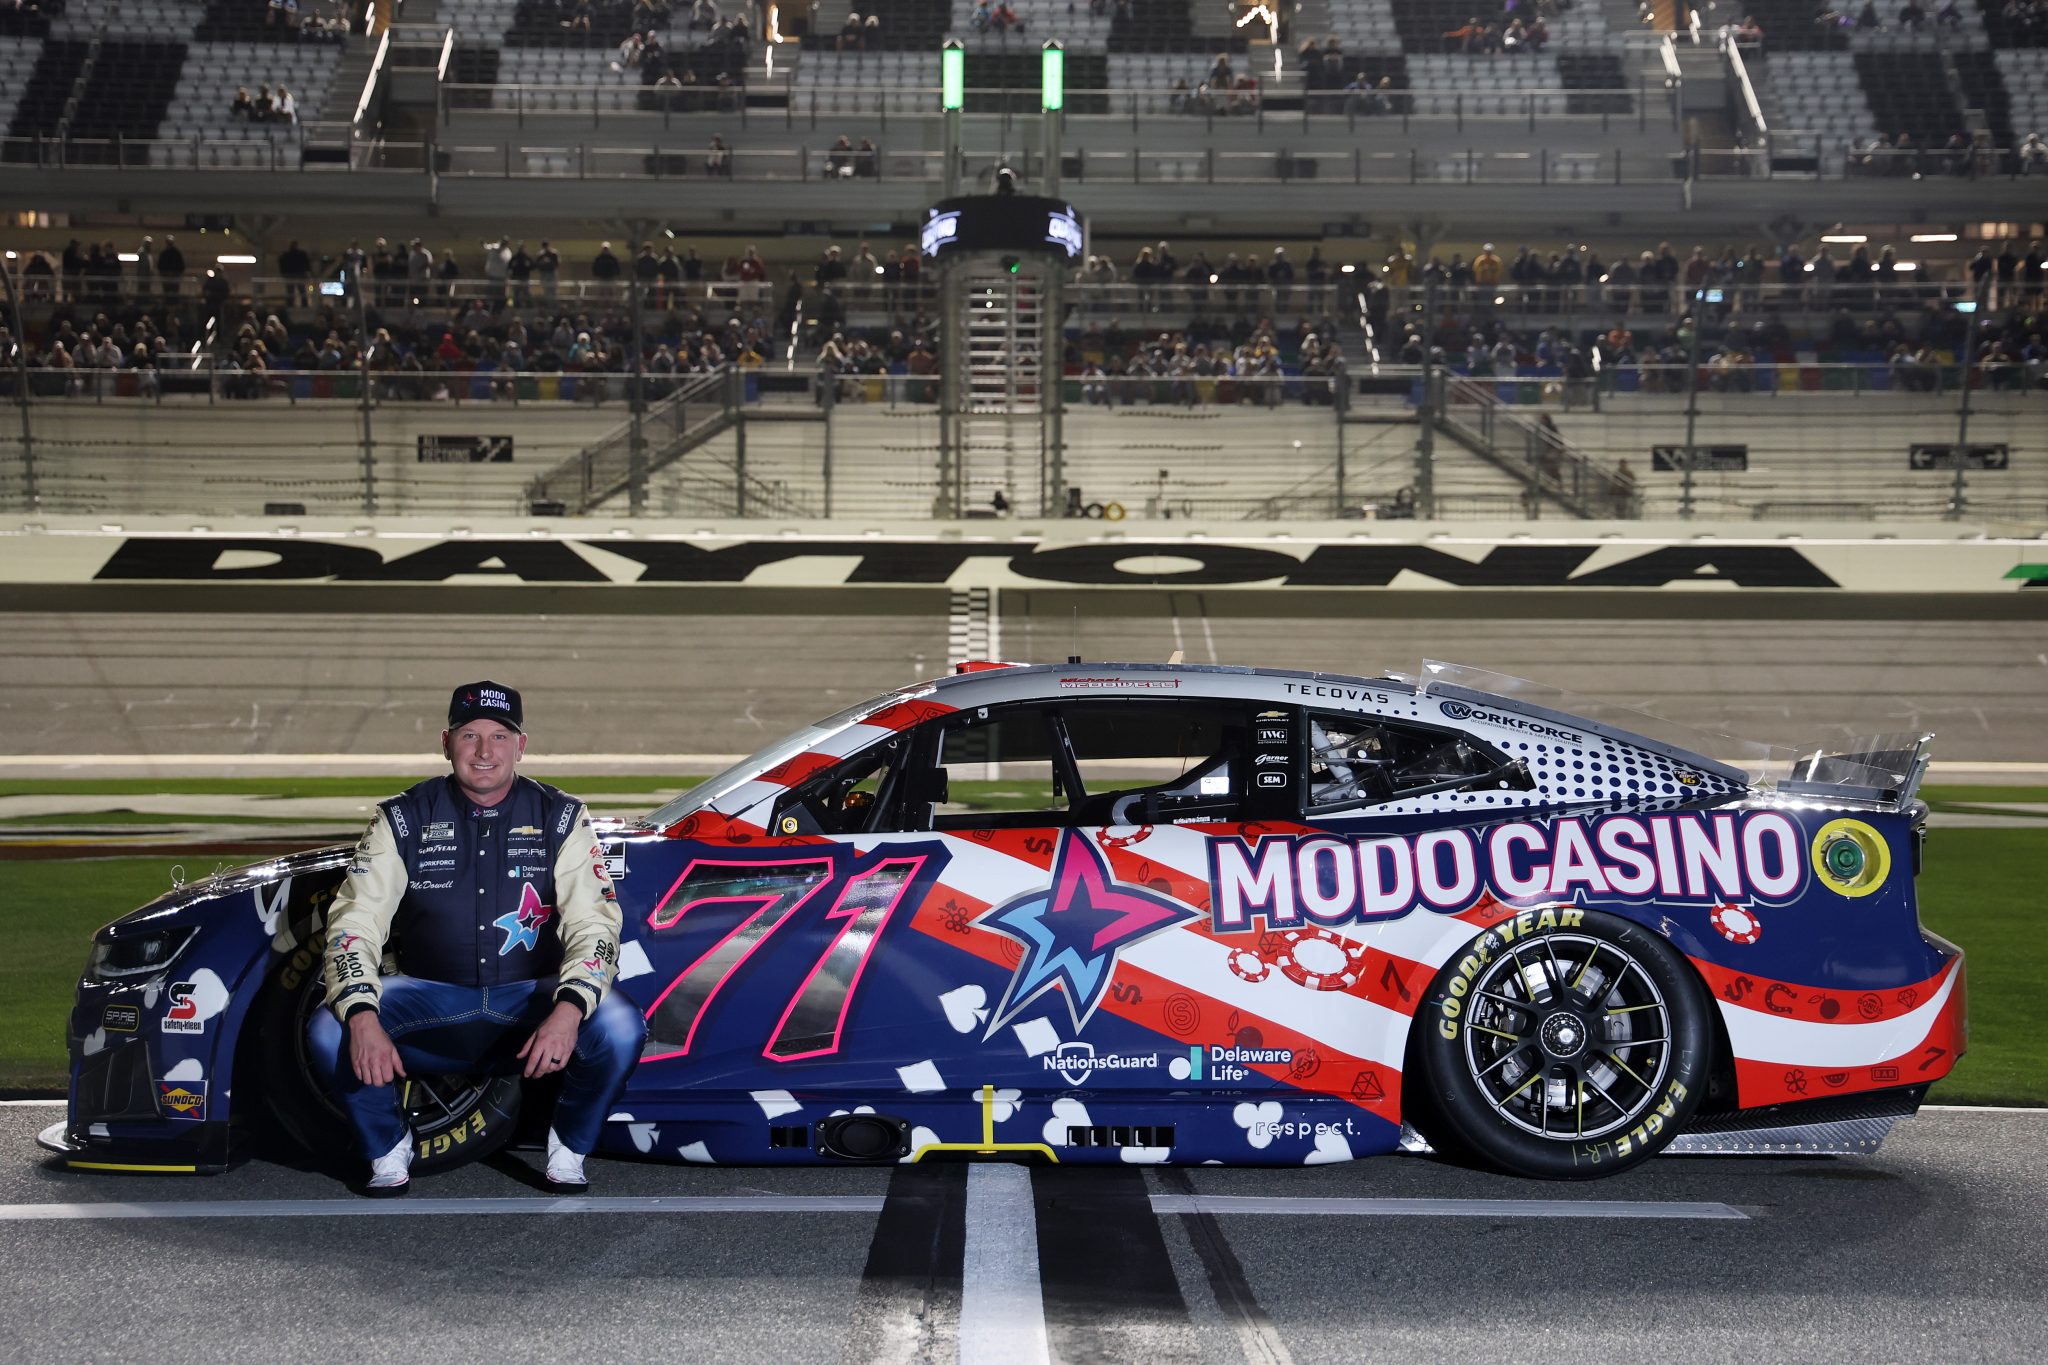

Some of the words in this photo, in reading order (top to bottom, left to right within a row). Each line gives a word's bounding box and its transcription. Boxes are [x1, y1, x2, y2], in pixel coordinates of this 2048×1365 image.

[92, 537, 1843, 589] DAYTONA
[480, 689, 506, 701] MODO
[480, 698, 511, 712] CASINO
[1283, 683, 1389, 704] TECOVAS
[1260, 730, 1285, 739] TWG
[1448, 703, 1583, 744] WORKFORCE
[1254, 753, 1289, 765] Garner
[1263, 775, 1281, 784] SEM
[390, 805, 410, 838] sparco
[556, 803, 575, 834] sparco
[1488, 811, 1801, 898] CASINO
[409, 880, 454, 890] McDowell
[1214, 827, 1478, 927] MODO
[333, 954, 350, 983] CSIN
[639, 854, 928, 1063] 71
[1043, 1053, 1158, 1071] NationsGuard
[1211, 1046, 1292, 1063] Delaware
[162, 1094, 202, 1106] SUNOCO
[1255, 1117, 1361, 1140] respect.
[1615, 1078, 1688, 1158] EAGLE
[419, 1108, 487, 1159] EAGL
